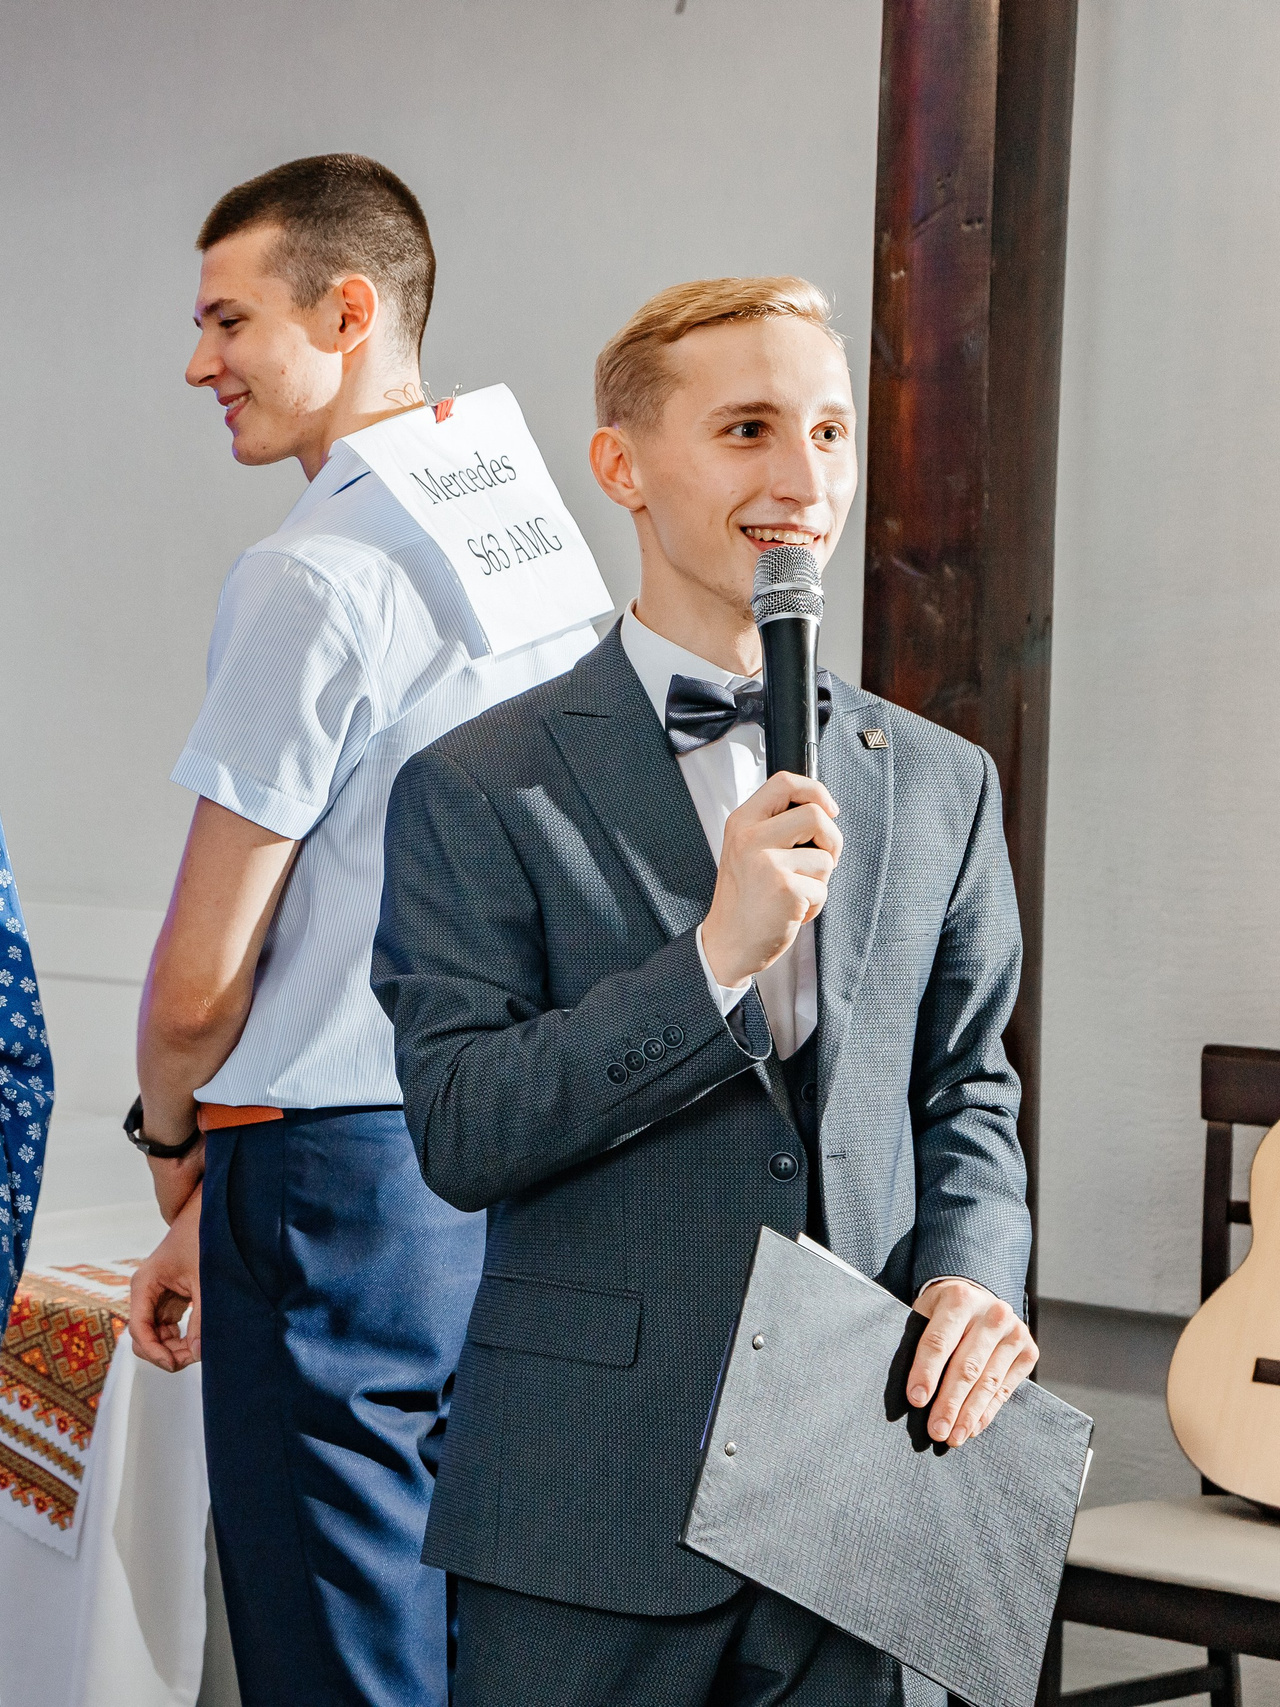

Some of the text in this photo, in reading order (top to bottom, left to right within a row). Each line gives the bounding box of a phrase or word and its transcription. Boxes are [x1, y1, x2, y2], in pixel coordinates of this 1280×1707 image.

[409, 450, 517, 505] Mercedes
[466, 517, 563, 576] S63 AMG
